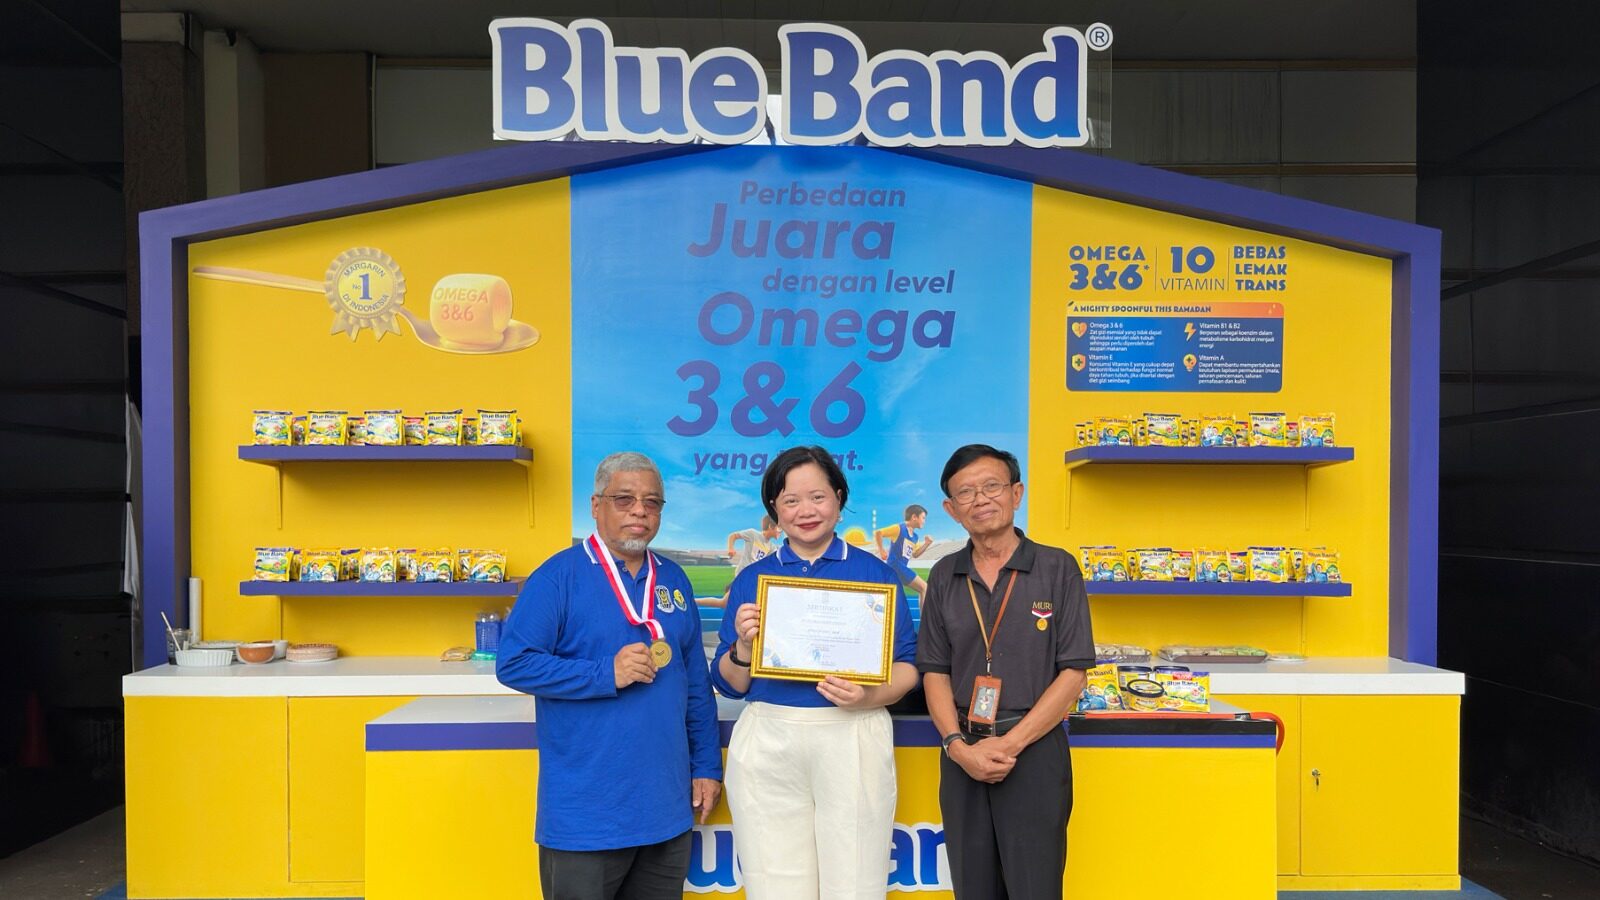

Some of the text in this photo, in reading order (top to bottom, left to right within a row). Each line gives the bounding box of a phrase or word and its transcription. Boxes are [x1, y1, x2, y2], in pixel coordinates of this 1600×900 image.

[495, 24, 761, 138] Blue
[784, 28, 1083, 140] Band
[739, 180, 906, 208] Perbedaan
[687, 203, 895, 260] Juara
[1069, 246, 1146, 261] OMEGA
[1170, 246, 1215, 274] 10
[1233, 246, 1286, 259] BEBAS
[343, 262, 386, 278] MARGARIN
[1235, 263, 1287, 276] LEMAK
[762, 268, 956, 299] dengan level
[1160, 278, 1225, 291] VITAMIN
[1235, 279, 1287, 291] TRANS
[350, 294, 390, 312] INDONESIA
[433, 287, 489, 304] OMEGA
[440, 303, 475, 322] 3&6
[697, 291, 956, 363] Omega
[666, 359, 867, 439] 3&6
[694, 451, 768, 477] yang
[1032, 600, 1053, 611] MURI
